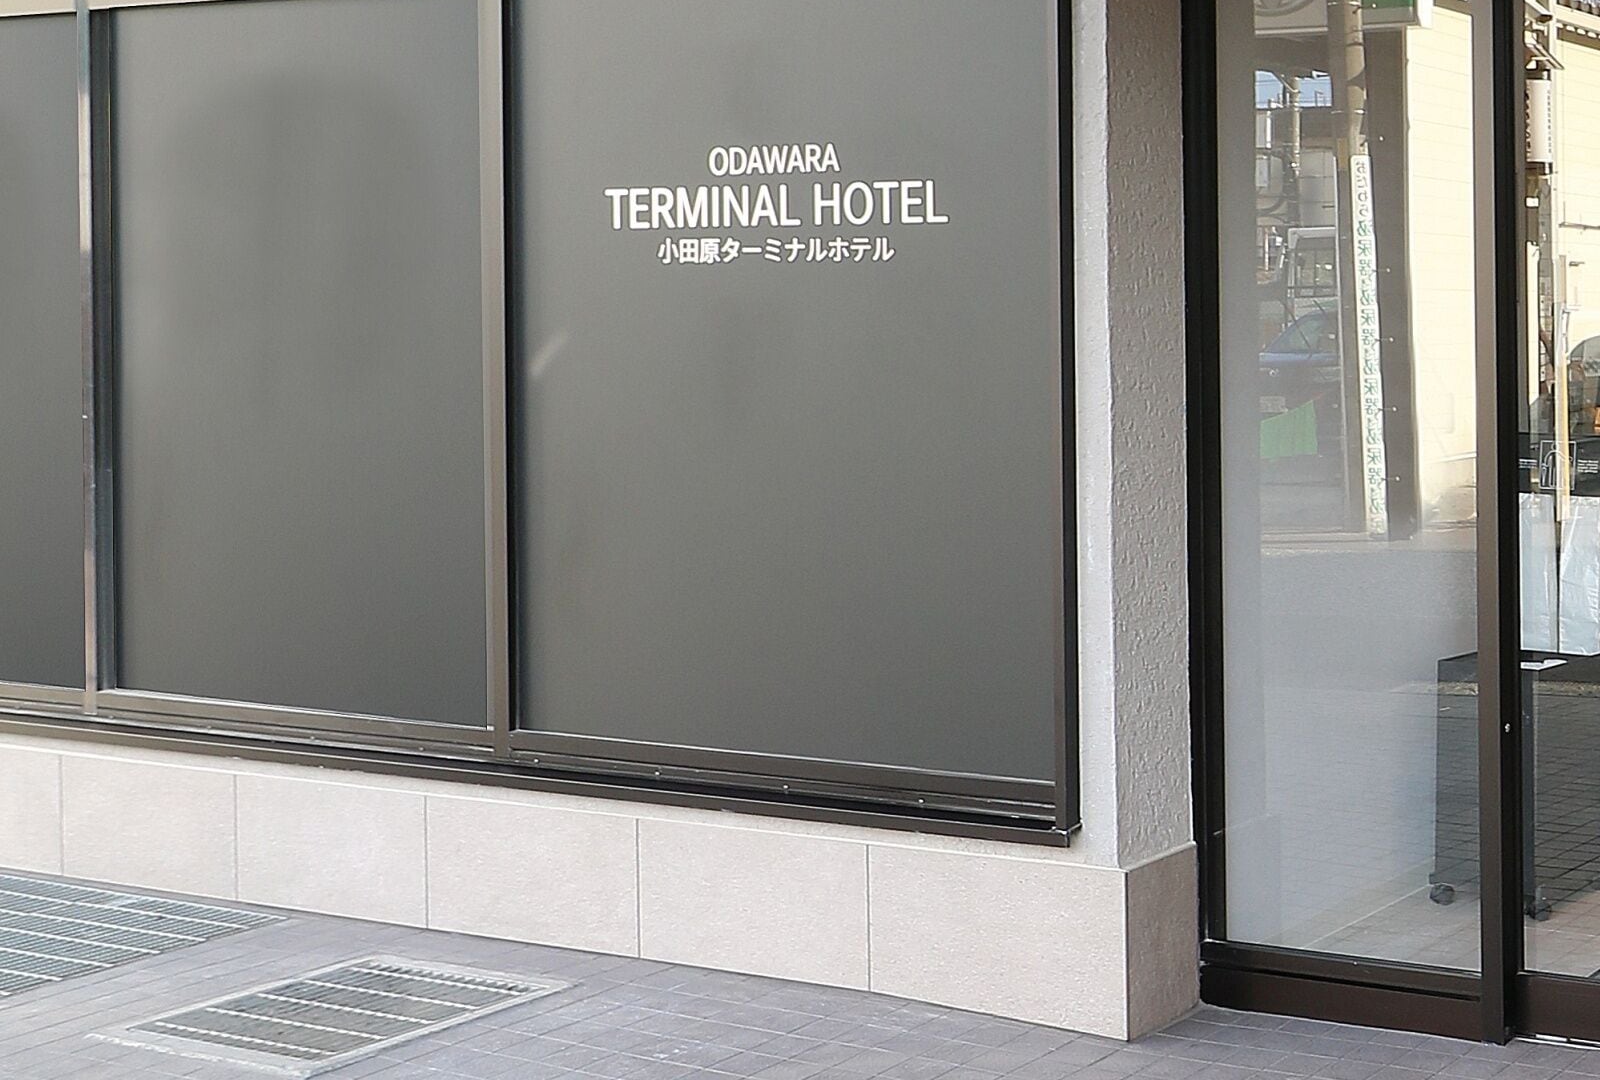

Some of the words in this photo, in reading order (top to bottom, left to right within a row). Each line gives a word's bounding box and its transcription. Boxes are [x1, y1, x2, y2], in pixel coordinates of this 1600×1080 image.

[708, 143, 840, 176] ODAWARA
[604, 185, 801, 231] TERMINAL
[813, 179, 949, 225] HOTEL
[657, 236, 895, 264] 小田原ターミナルホテル
